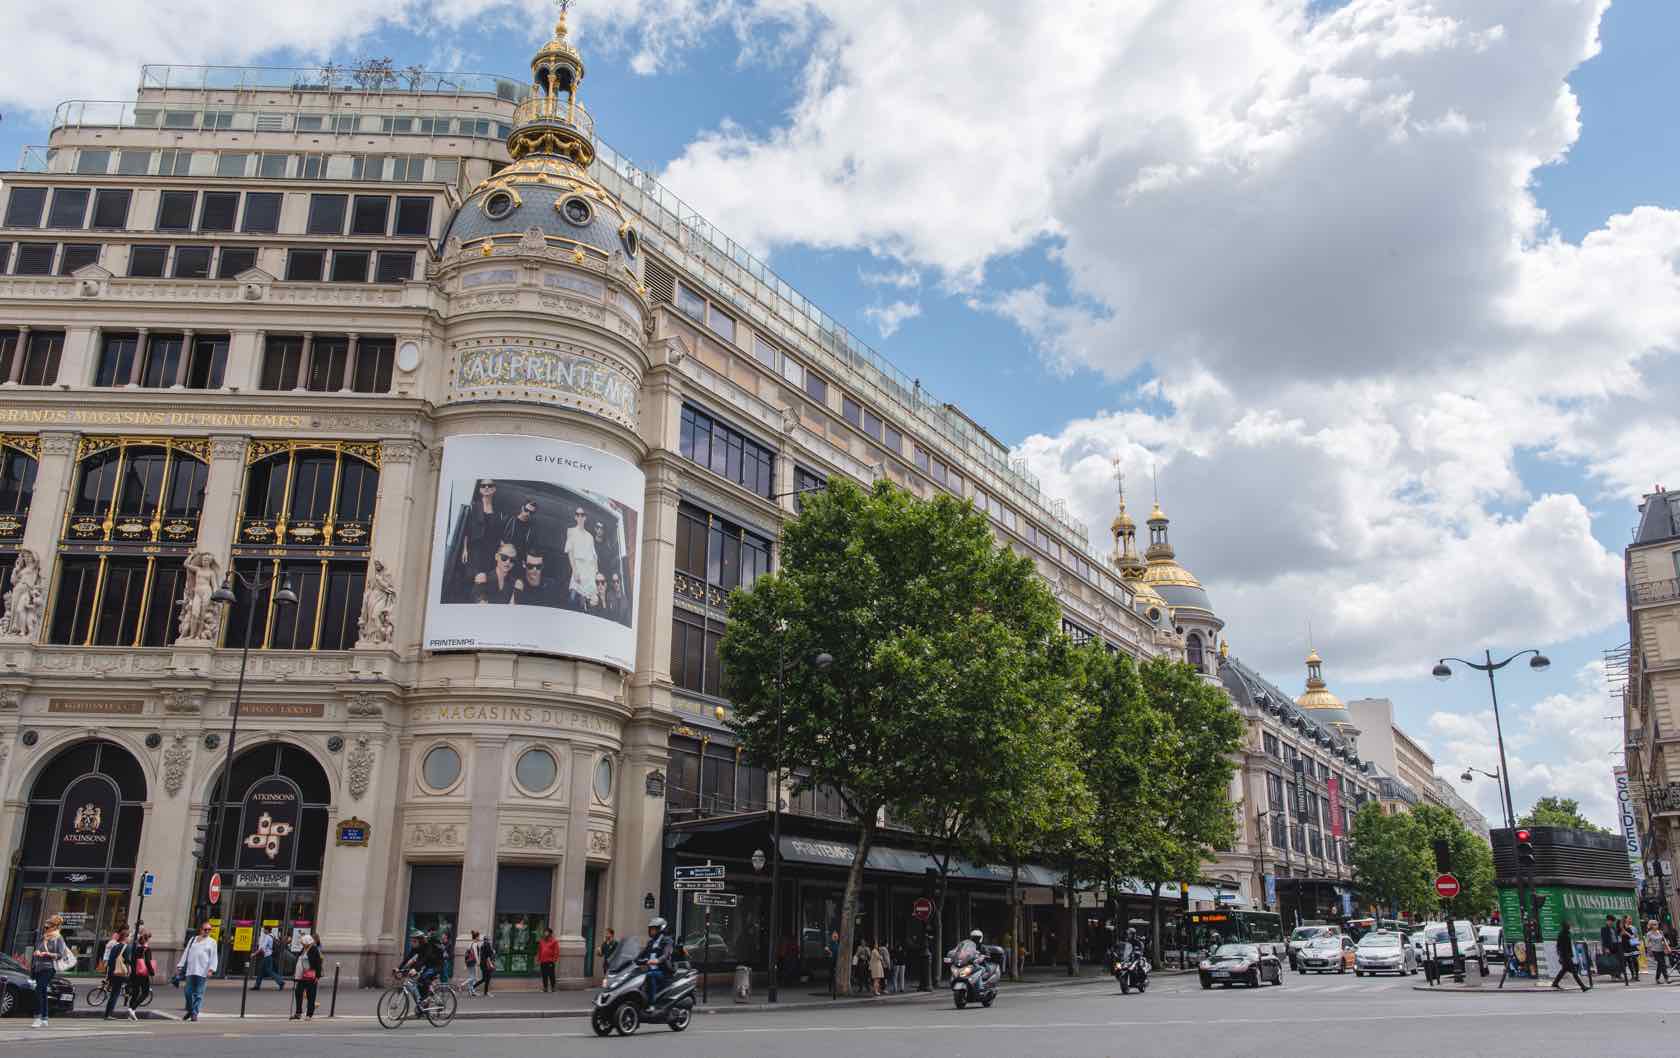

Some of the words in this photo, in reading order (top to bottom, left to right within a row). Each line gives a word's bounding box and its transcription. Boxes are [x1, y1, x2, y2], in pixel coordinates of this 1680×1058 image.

[200, 413, 300, 426] PRINTEMPS
[535, 454, 593, 472] GIVENCHY
[430, 639, 475, 647] PRINTEMPS
[438, 704, 533, 721] MAGASINS
[541, 710, 564, 724] DU
[252, 793, 295, 801] ATKINSONS
[1617, 777, 1639, 853] SOLDES
[64, 834, 107, 842] ATKINSONS
[791, 840, 856, 860] PRINTEMPS
